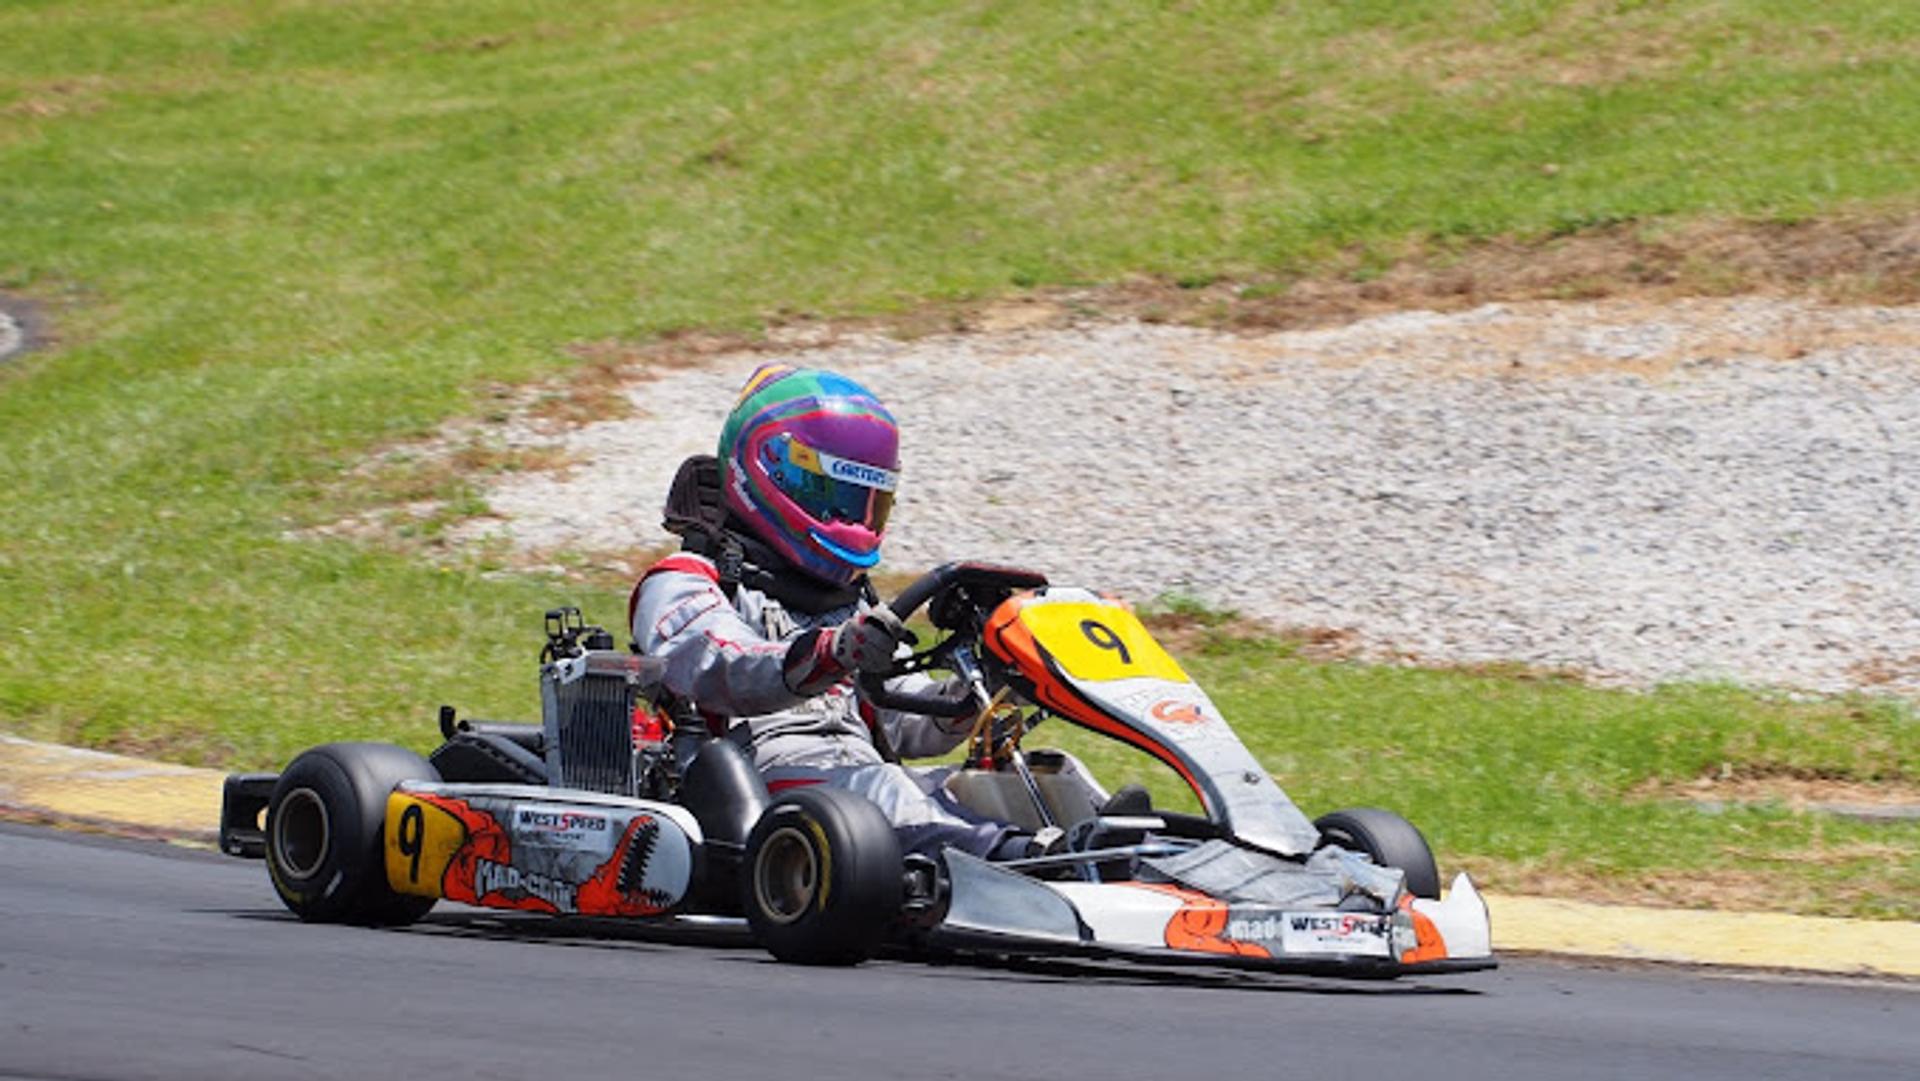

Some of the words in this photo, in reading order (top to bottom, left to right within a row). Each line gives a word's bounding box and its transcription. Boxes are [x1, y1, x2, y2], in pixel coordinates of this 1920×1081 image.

[1079, 619, 1132, 664] 9
[399, 804, 424, 883] 9
[519, 811, 606, 831] WESTSPEED
